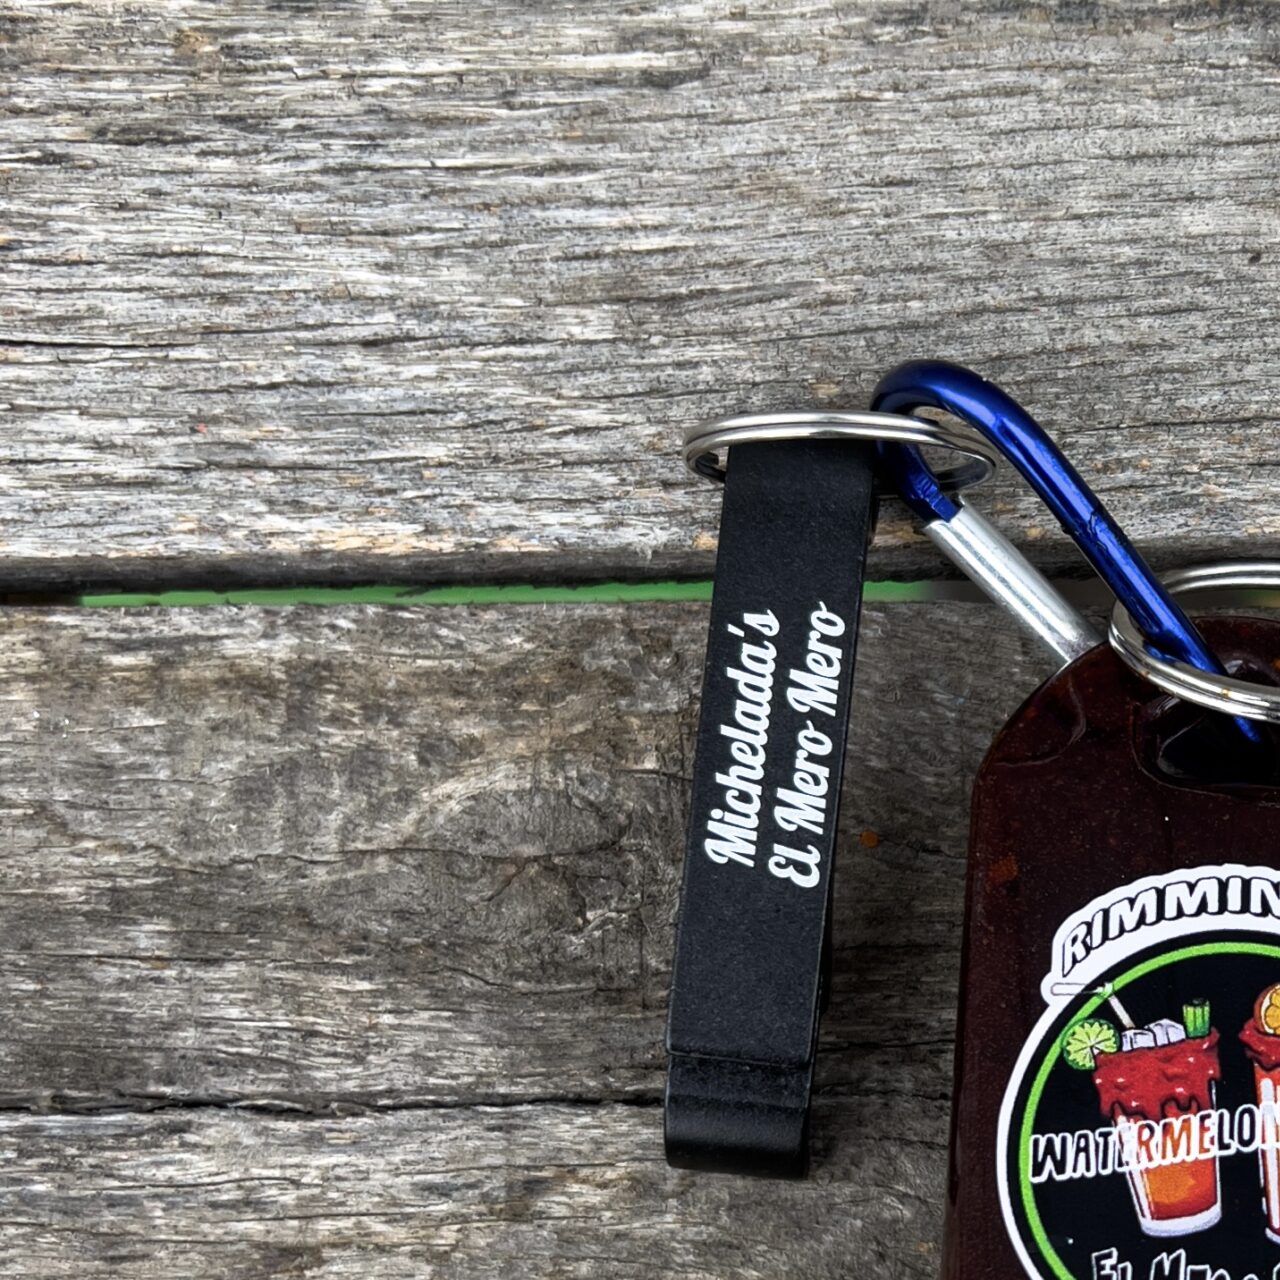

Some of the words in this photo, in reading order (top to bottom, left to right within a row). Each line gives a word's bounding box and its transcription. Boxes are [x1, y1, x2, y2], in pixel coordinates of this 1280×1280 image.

[786, 601, 845, 716] Mero
[704, 608, 780, 867] Michelada's
[774, 720, 833, 835] Mero
[768, 843, 821, 888] El
